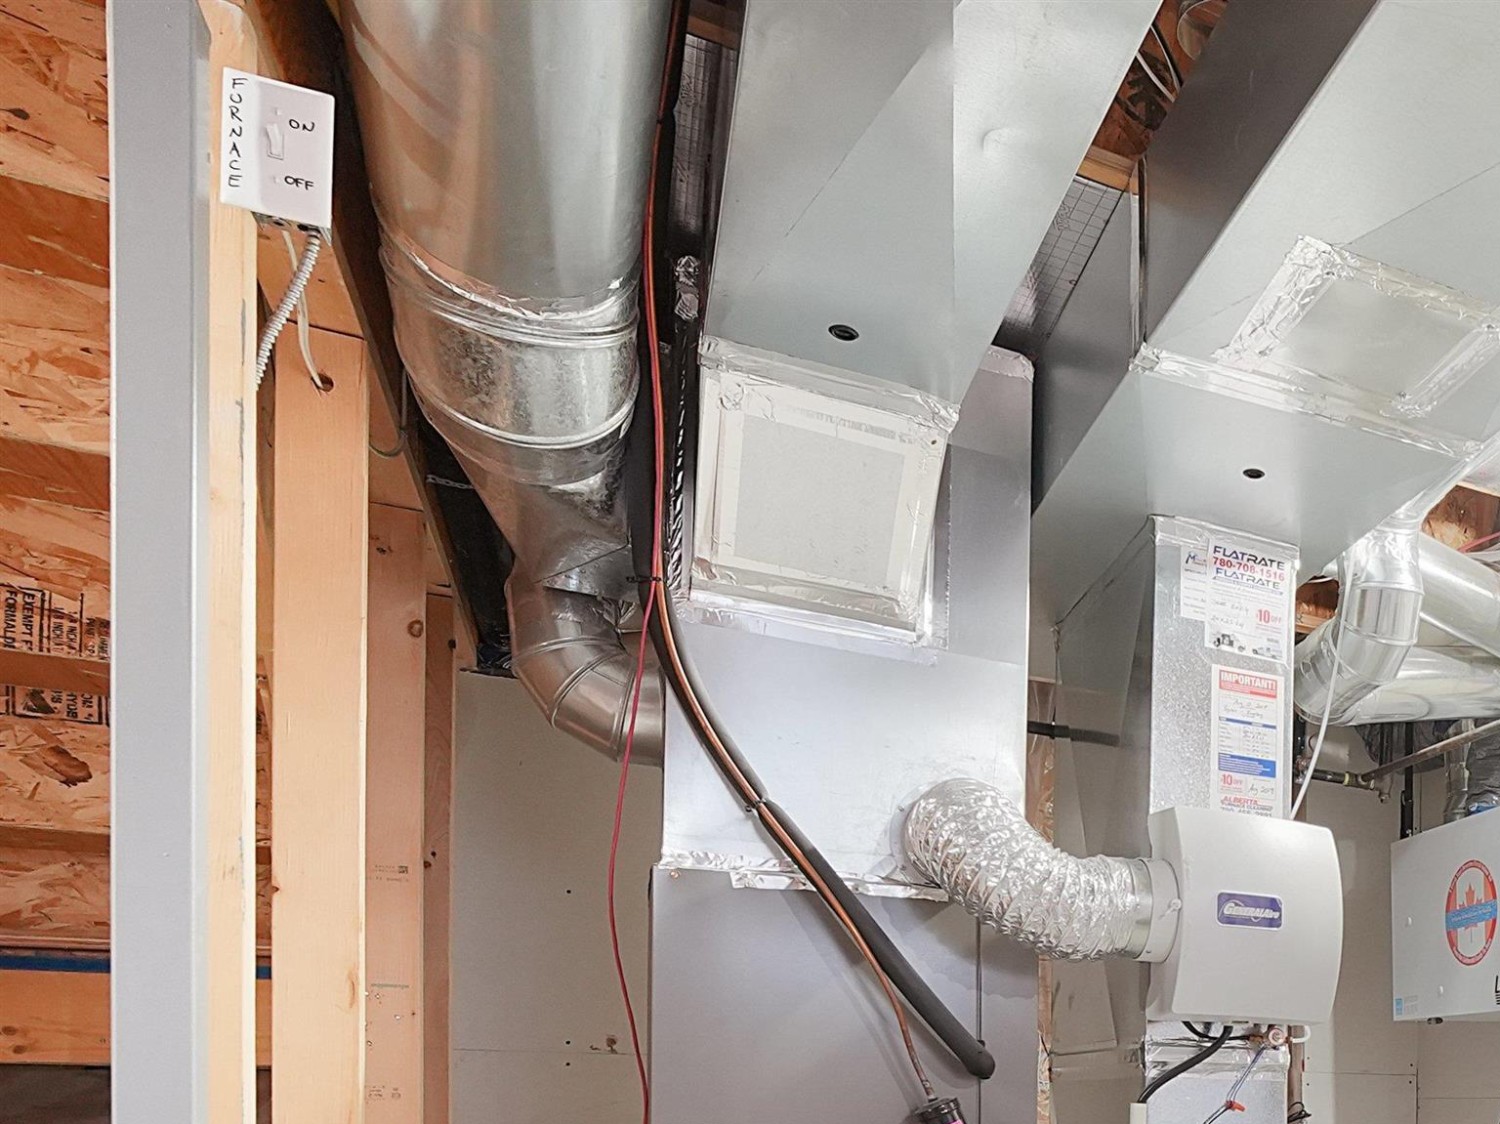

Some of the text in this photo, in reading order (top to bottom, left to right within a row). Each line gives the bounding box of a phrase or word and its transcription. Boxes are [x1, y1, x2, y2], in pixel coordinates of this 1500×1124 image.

[227, 77, 249, 188] FURNACE
[288, 118, 316, 132] ON
[284, 175, 315, 191] OFF
[1213, 545, 1286, 571] FLATRATE
[1215, 567, 1281, 590] FLATRATE
[1220, 670, 1276, 690] IMPORTANT!
